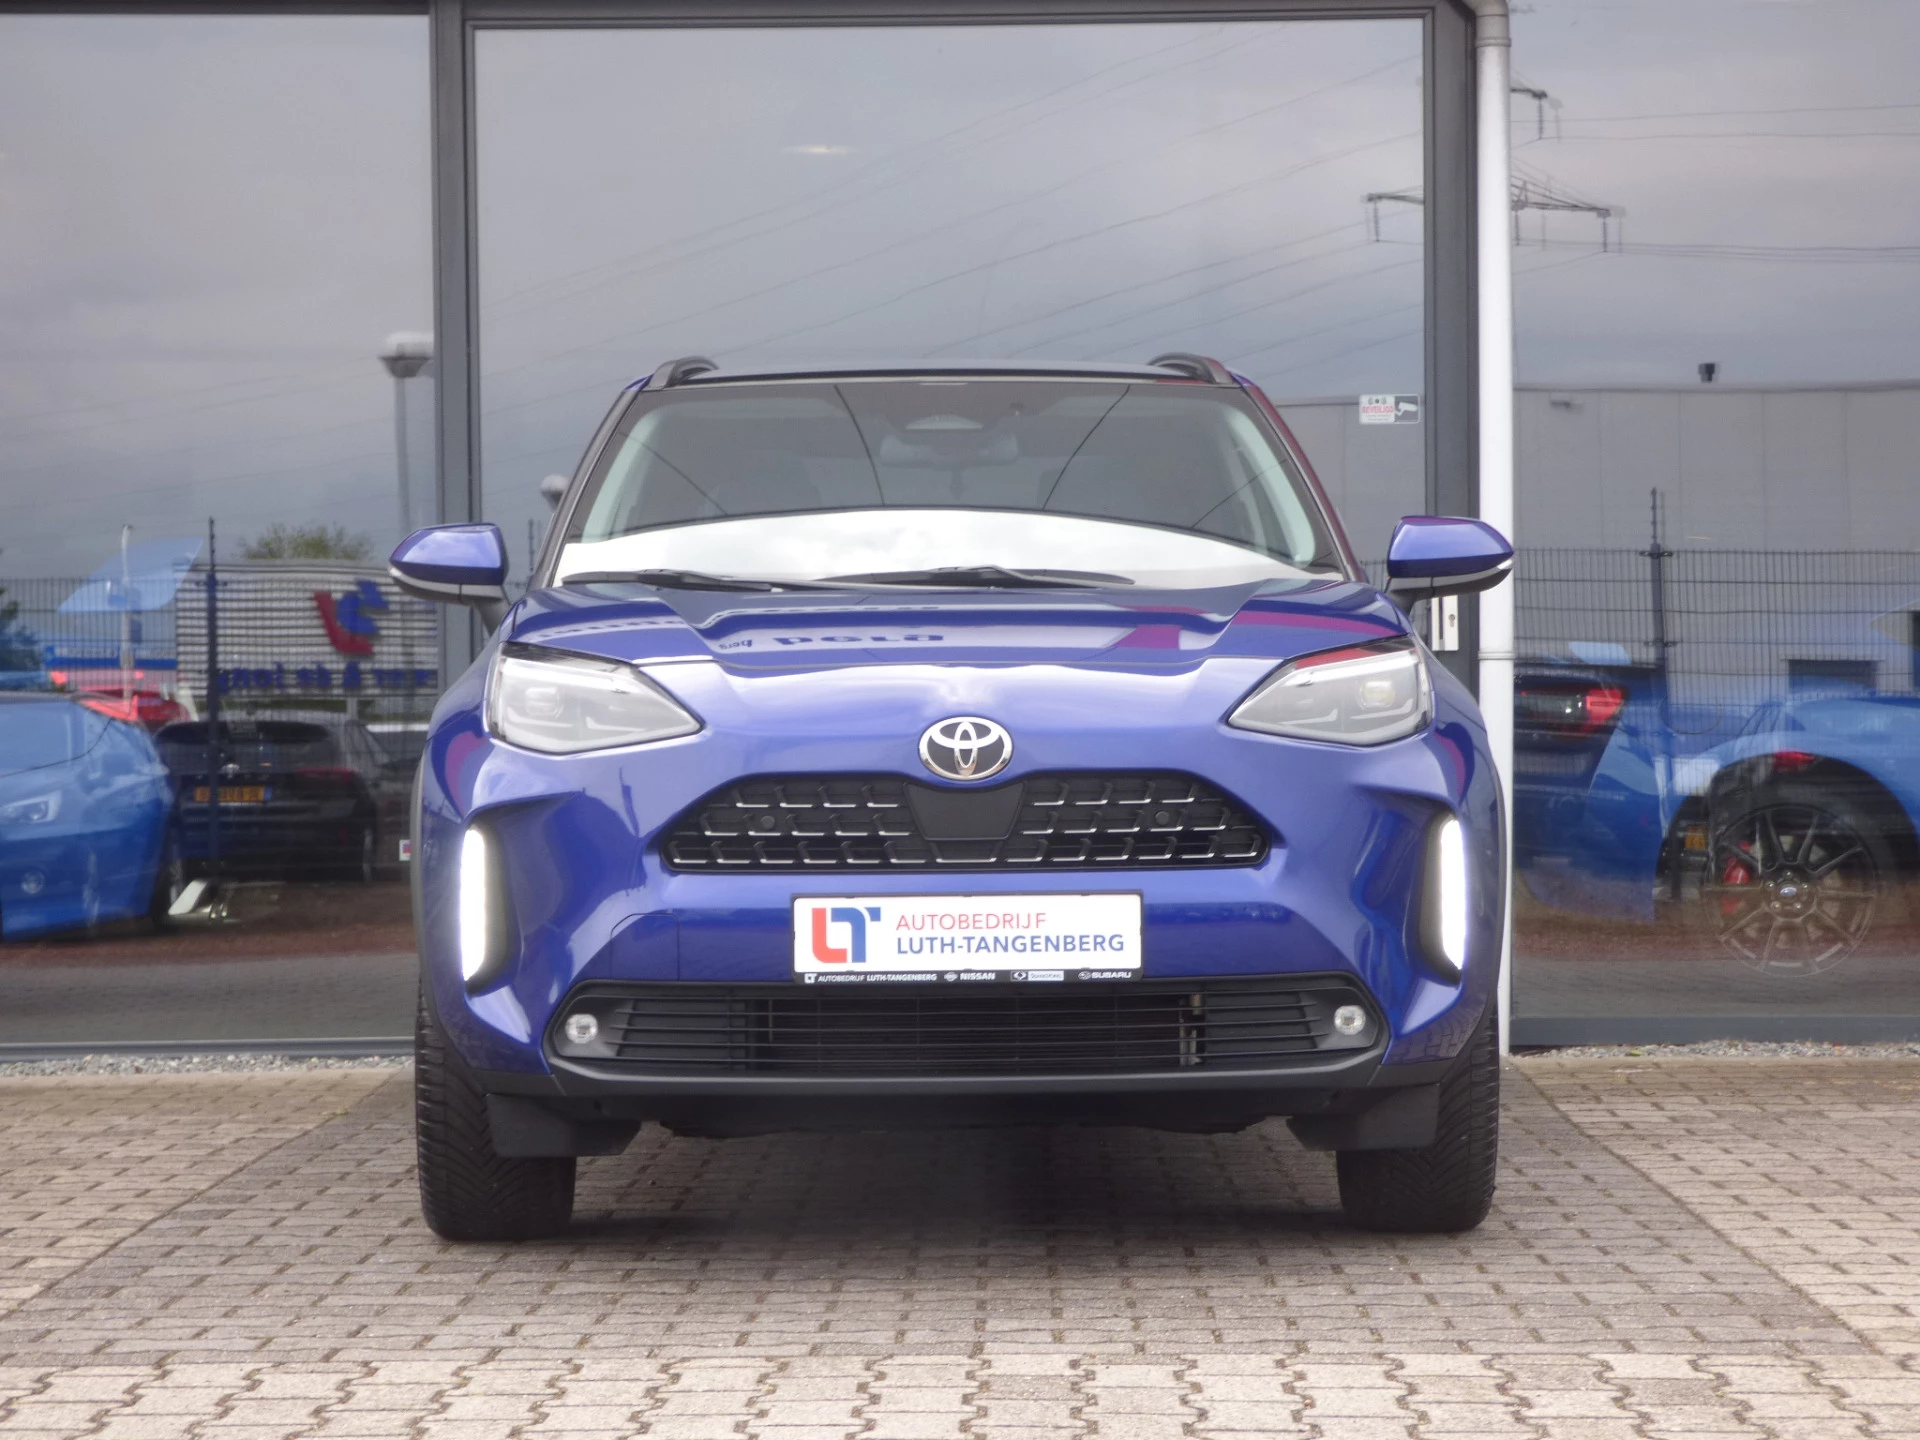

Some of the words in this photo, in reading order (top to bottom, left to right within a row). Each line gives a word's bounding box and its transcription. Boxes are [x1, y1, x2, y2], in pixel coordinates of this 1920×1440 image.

[896, 912, 1047, 931] AUTOBEDRIJF
[897, 934, 1125, 955] LUTH-TANGENBERG
[818, 974, 866, 983] AUTOBEDRIJF
[867, 973, 937, 982] LUTH-TANGENBERG
[960, 972, 996, 981] NISSAN
[1091, 971, 1132, 979] SUBARU
